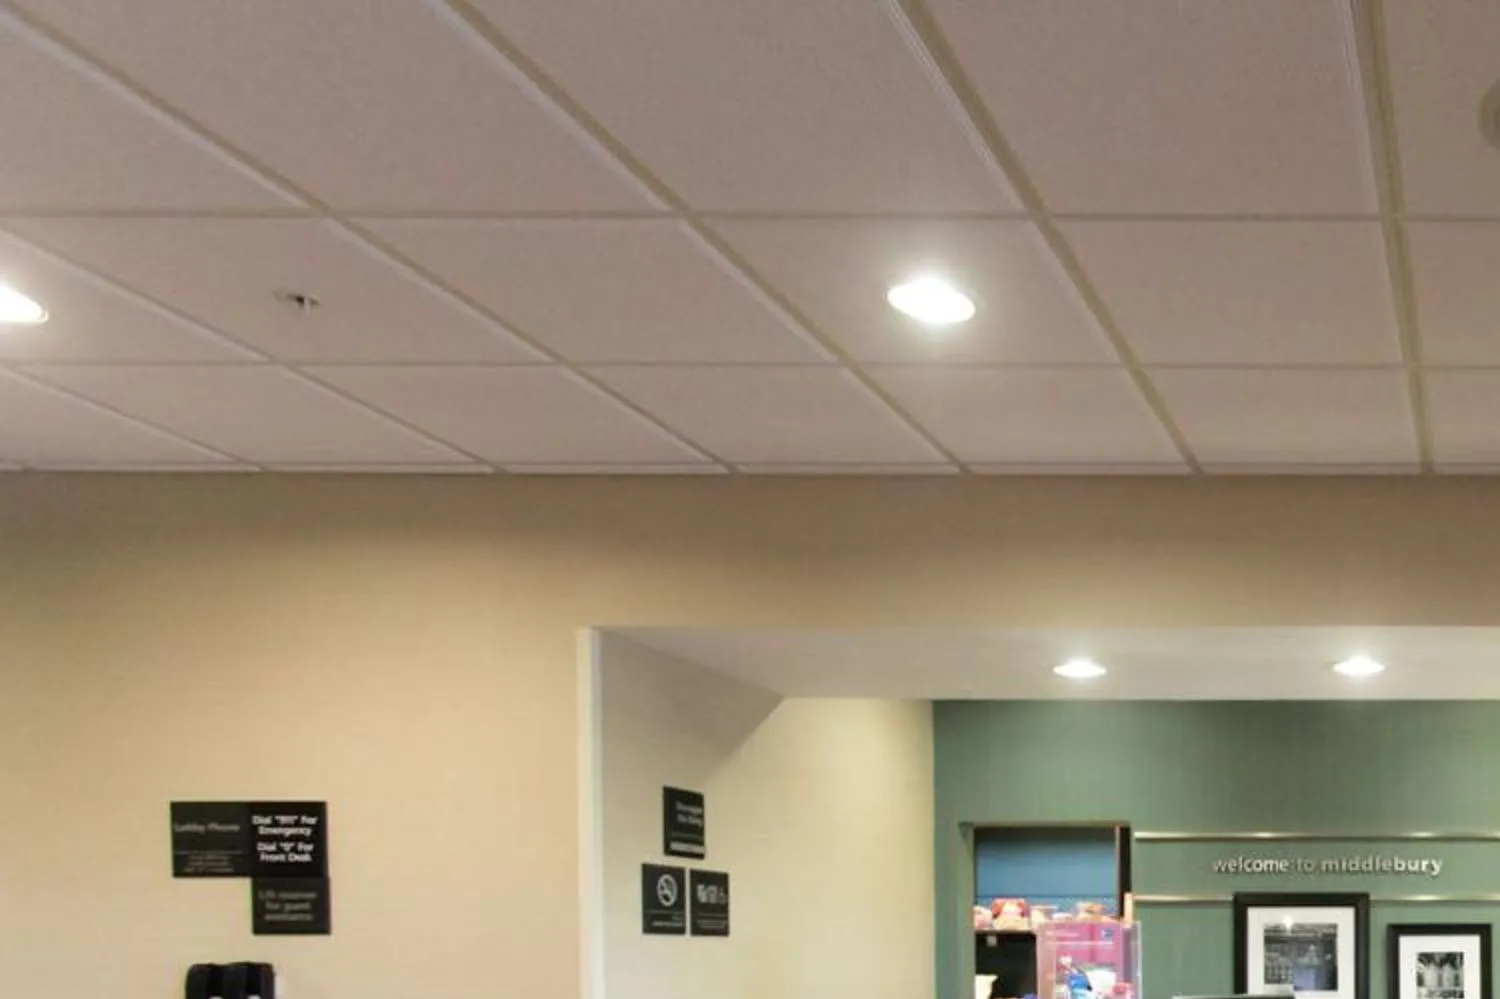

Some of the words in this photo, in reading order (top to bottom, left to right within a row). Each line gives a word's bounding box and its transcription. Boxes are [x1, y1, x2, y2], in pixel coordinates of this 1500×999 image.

[258, 826, 312, 837] Emergency
[288, 853, 312, 862] Desk
[1213, 856, 1290, 873] welcome
[1297, 858, 1316, 873] to
[1321, 855, 1443, 876] middlebury
